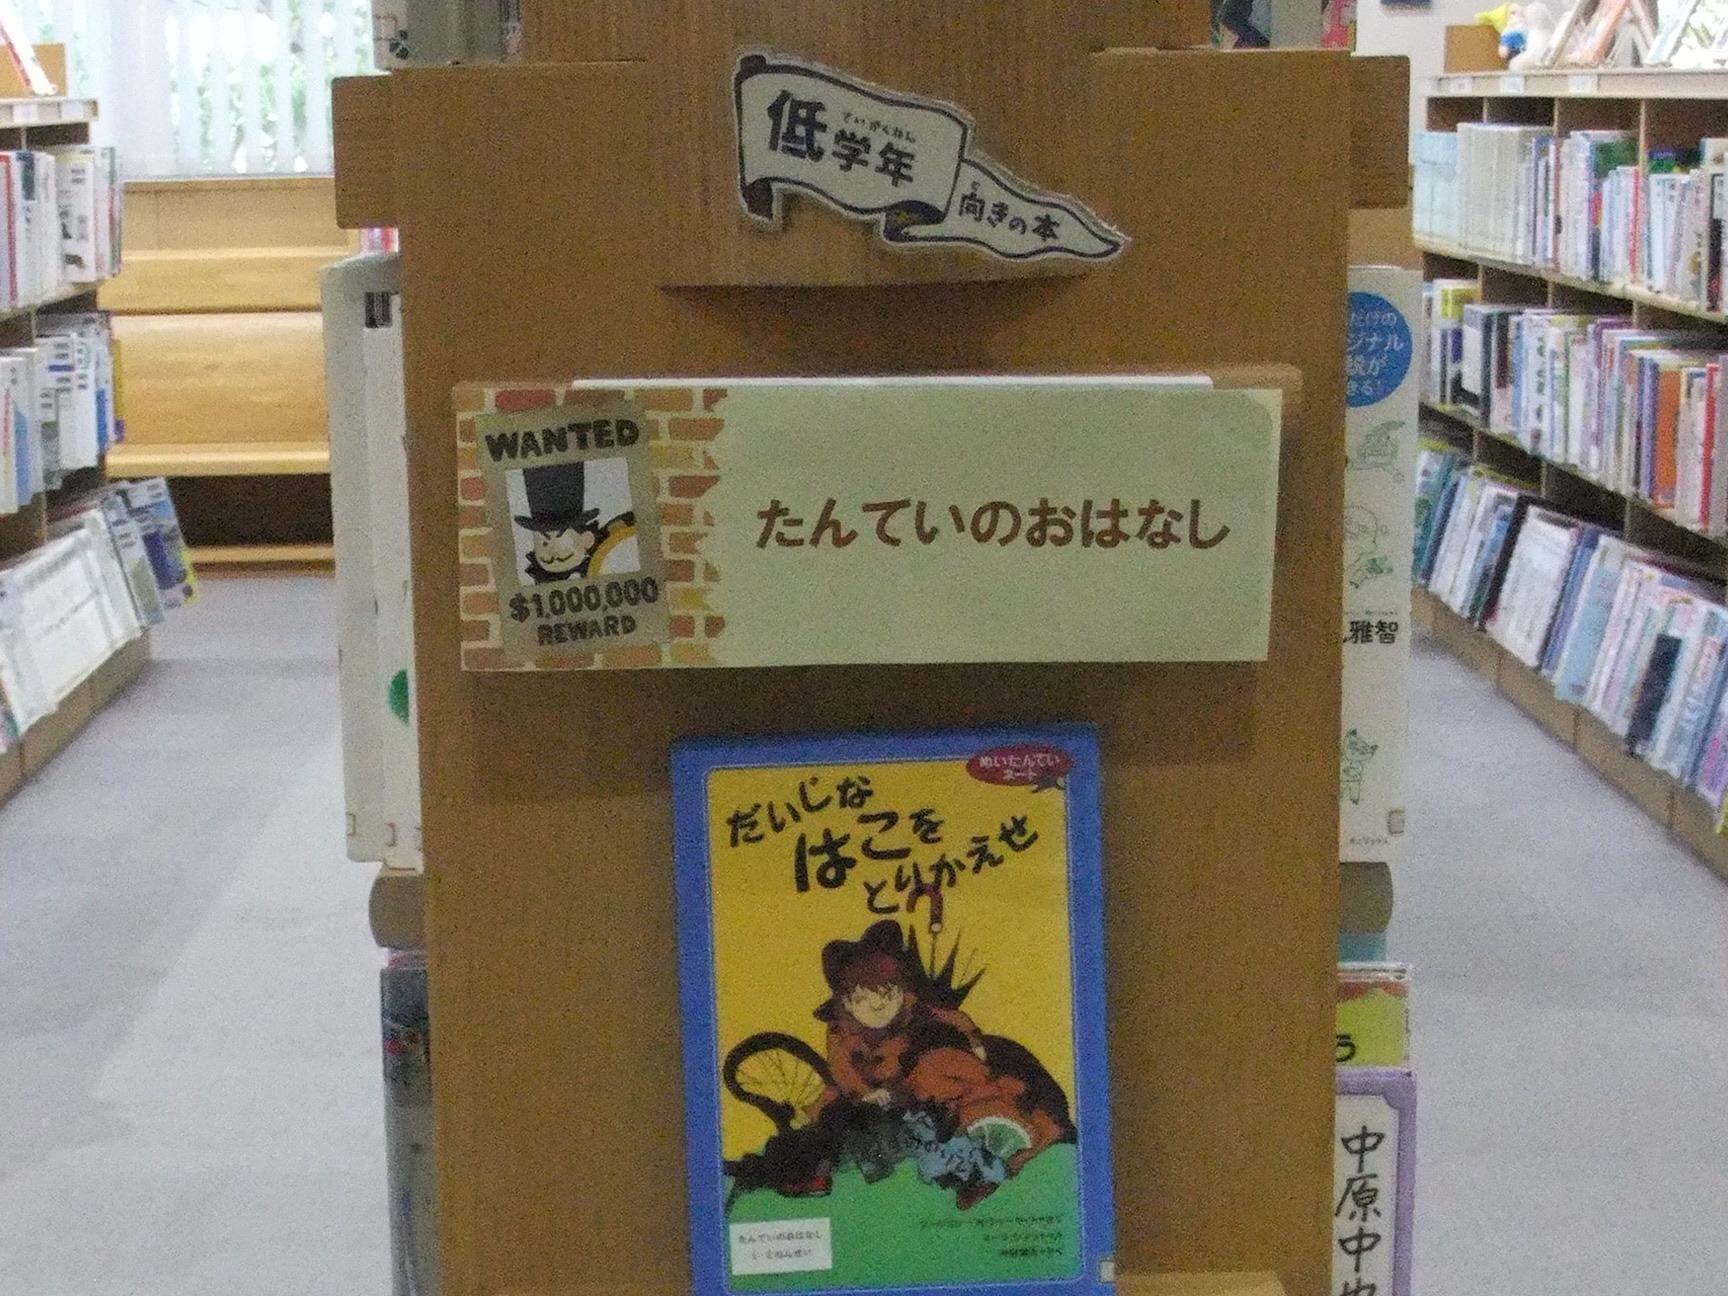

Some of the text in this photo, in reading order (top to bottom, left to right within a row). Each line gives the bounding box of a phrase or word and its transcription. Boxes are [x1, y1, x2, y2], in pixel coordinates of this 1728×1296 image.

[766, 88, 916, 188] 低学年
[958, 191, 1060, 242] 向きの本
[485, 418, 640, 463] WANTED
[755, 496, 1231, 550] たんていのおはなし
[509, 575, 660, 623] $1,000,000
[536, 614, 637, 647] REWARD
[1343, 619, 1400, 644] 雅智
[726, 776, 874, 848] だいじな
[794, 807, 944, 893] はこを
[862, 815, 1039, 914] とりかえせ
